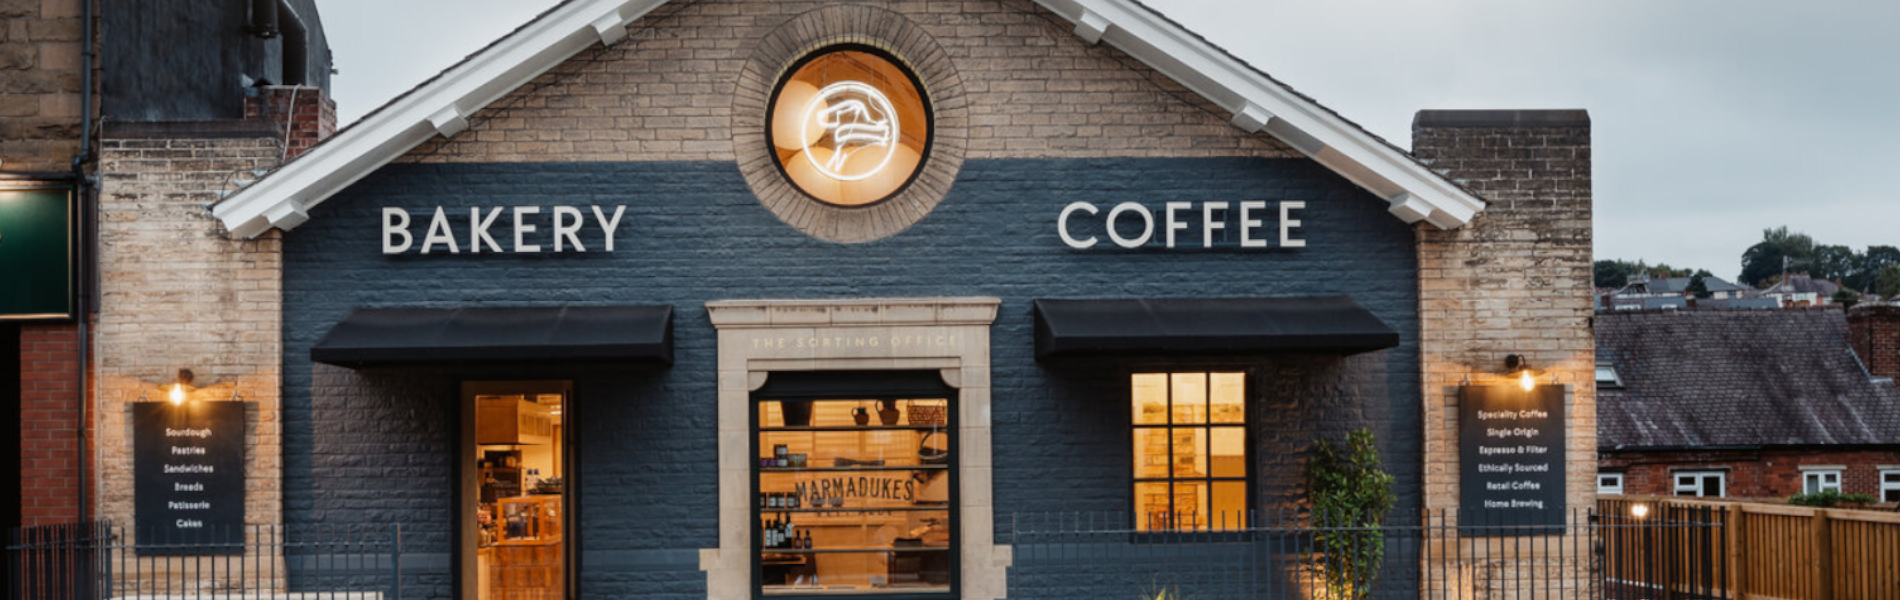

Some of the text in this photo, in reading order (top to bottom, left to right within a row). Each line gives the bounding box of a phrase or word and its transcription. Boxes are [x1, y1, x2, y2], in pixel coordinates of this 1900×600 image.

[382, 205, 627, 254] BAKERY
[1057, 200, 1306, 249] COFFEE
[752, 335, 957, 349] THE SORTING OFFICE
[1519, 409, 1548, 419] Coffee
[165, 427, 212, 438] Sourdough
[1486, 427, 1540, 438] Single Origin
[171, 446, 206, 455] Pastries
[1479, 446, 1548, 456] Espresso & Filter
[164, 464, 214, 474] Sandwiches
[1478, 463, 1549, 474] Ethically Sourced
[174, 482, 204, 492] Breads
[795, 476, 914, 502] MARMADUKES
[1486, 480, 1540, 490] Retail Coffee
[168, 501, 210, 510] Patisserie
[1484, 499, 1544, 510] Home Brewing
[175, 518, 203, 529] Cakes
